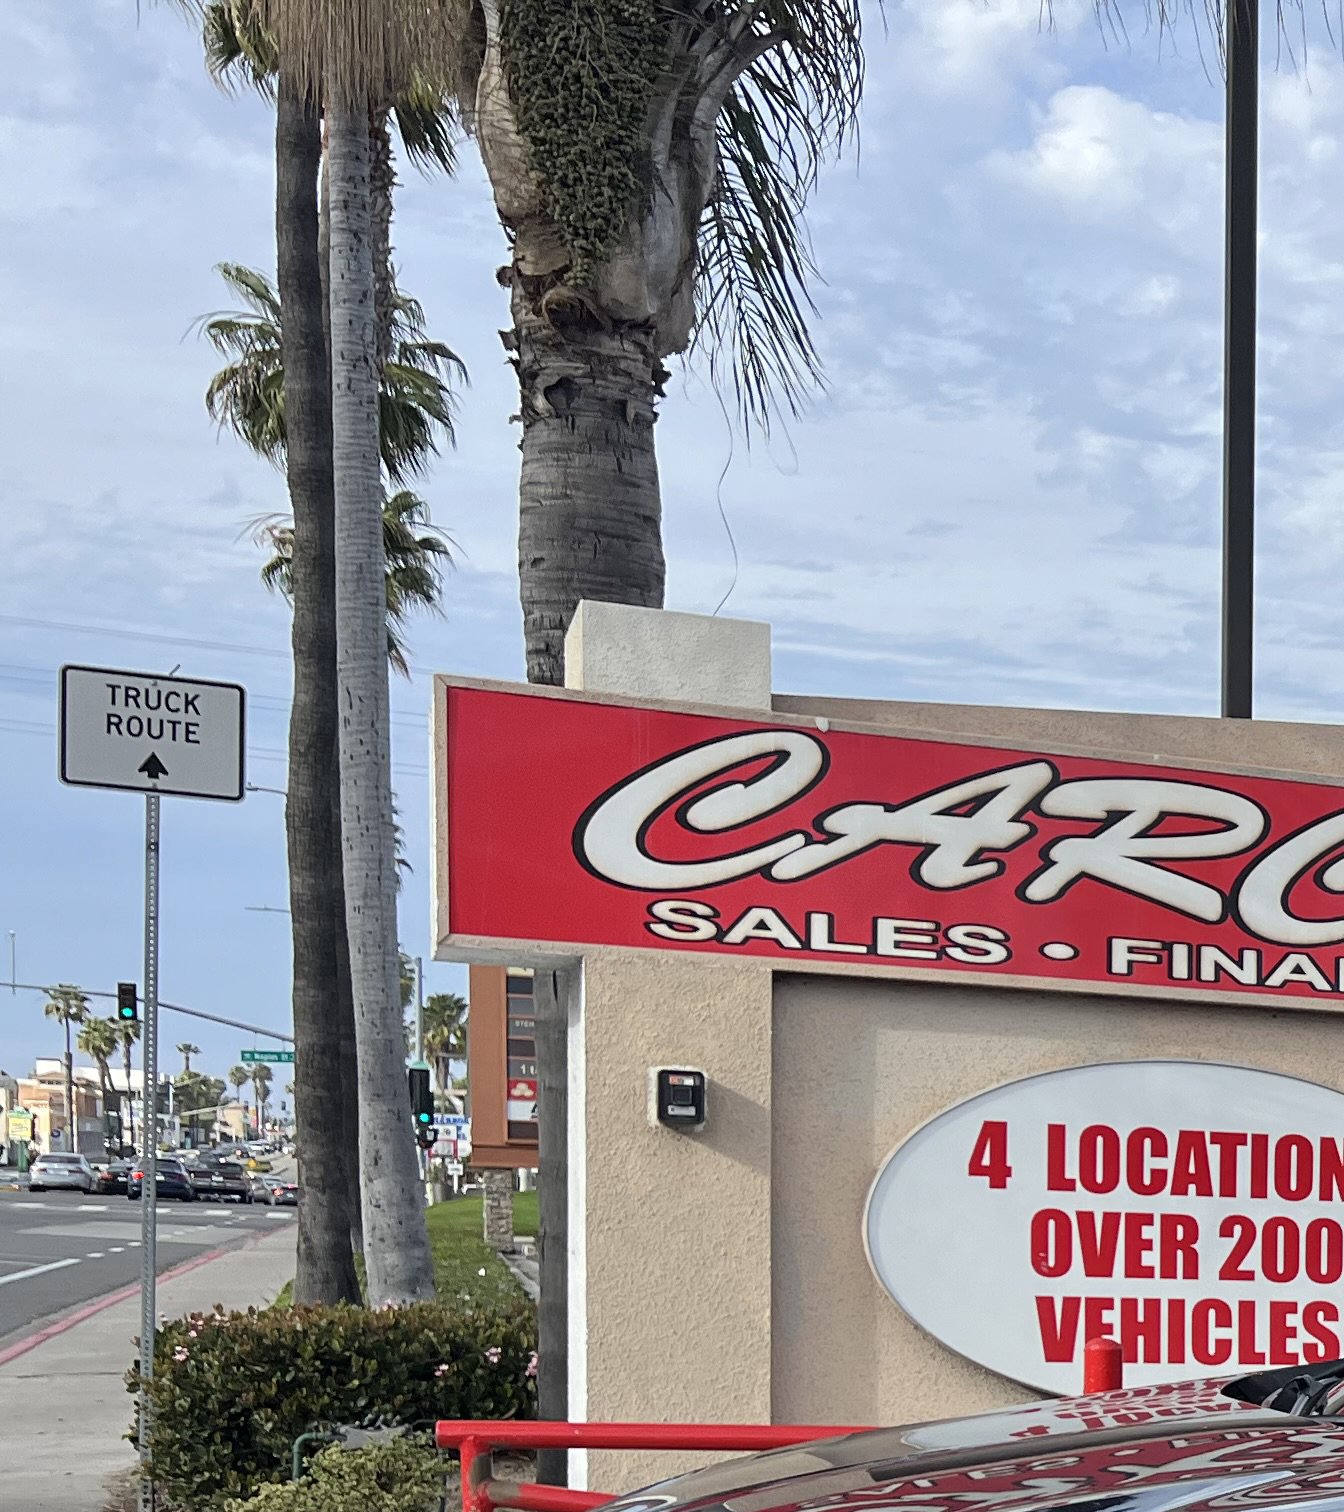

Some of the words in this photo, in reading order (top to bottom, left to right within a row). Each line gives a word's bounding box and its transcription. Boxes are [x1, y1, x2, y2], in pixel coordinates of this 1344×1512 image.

[106, 683, 201, 715] TRUCK
[106, 713, 201, 744] ROUTE
[644, 898, 1012, 965] SALES
[968, 1120, 1012, 1189] 4
[1029, 1207, 1200, 1281] OVER
[1217, 1213, 1344, 1285] 200
[1034, 1295, 1341, 1366] VEHICLES
